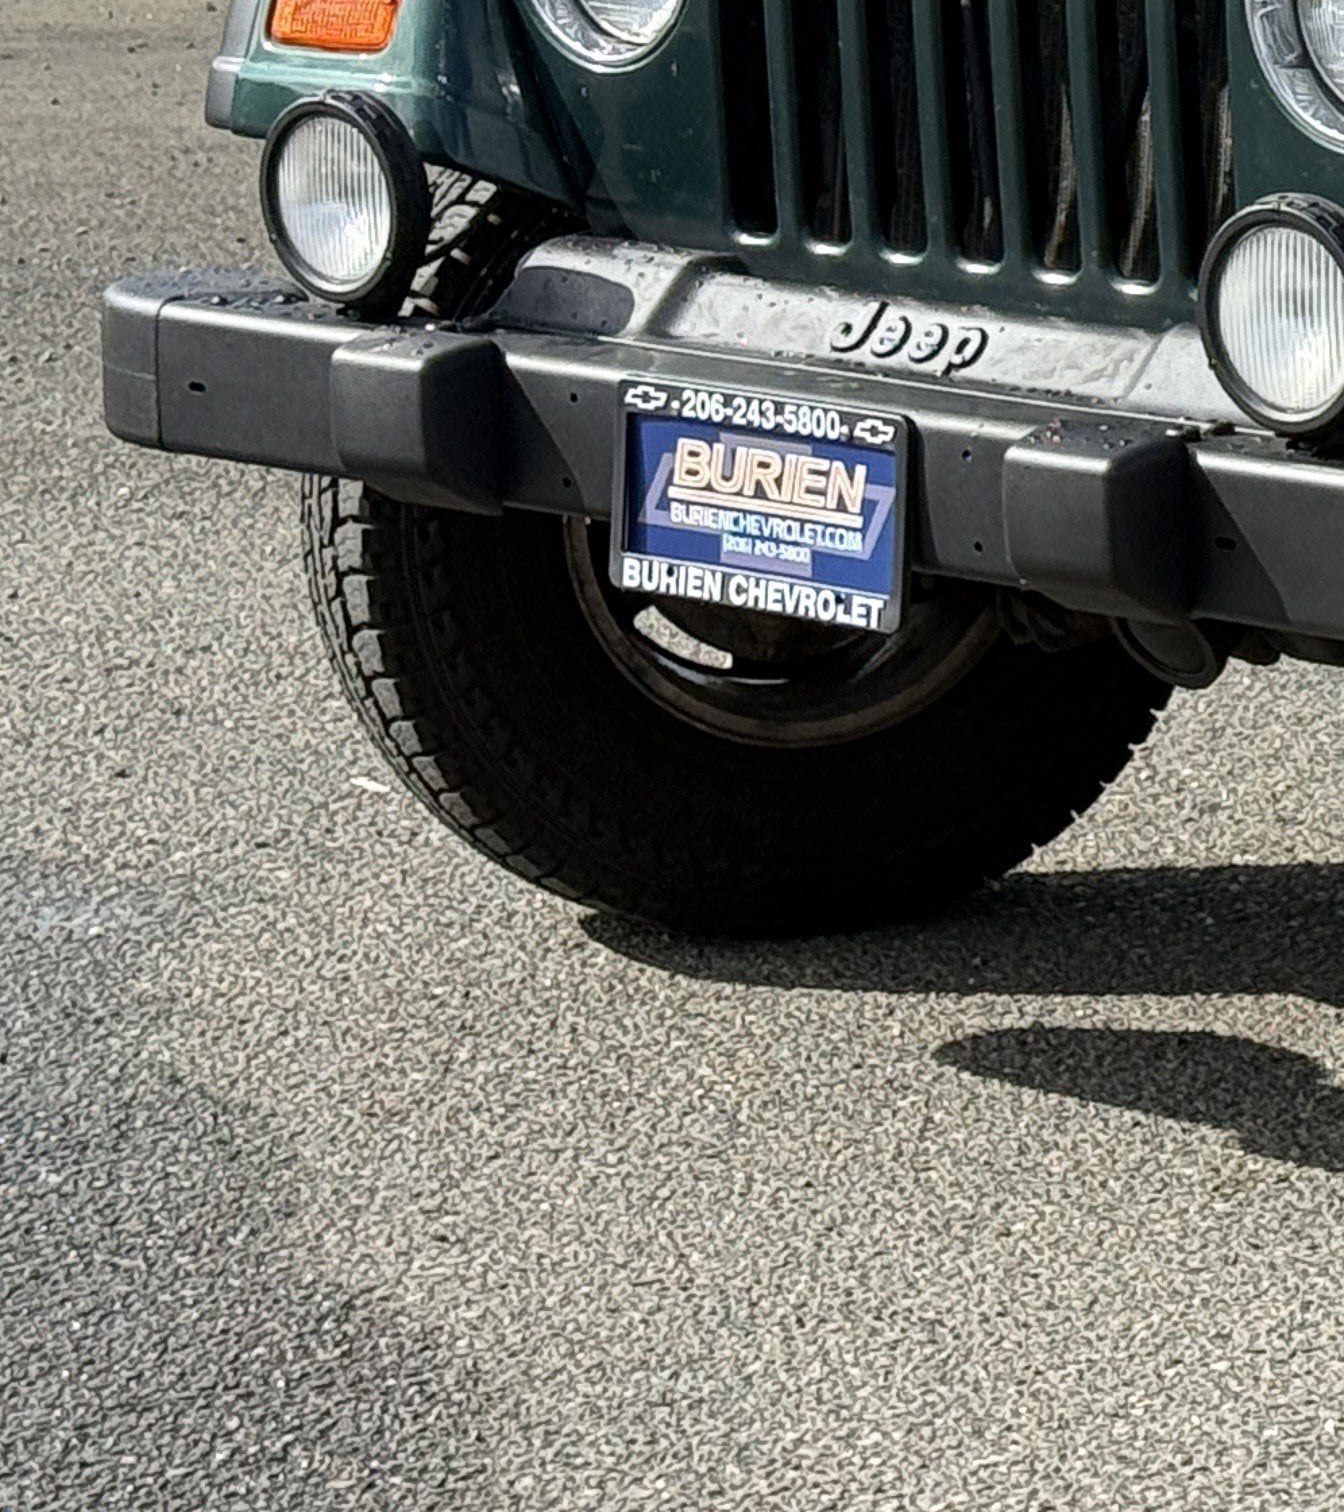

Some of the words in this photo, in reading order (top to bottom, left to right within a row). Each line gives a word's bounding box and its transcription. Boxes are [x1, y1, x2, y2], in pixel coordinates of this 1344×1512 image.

[830, 300, 989, 376] Jeep
[673, 437, 867, 514] BURIEN
[622, 557, 725, 602] BURIEN
[729, 574, 885, 629] CHEVROLET
